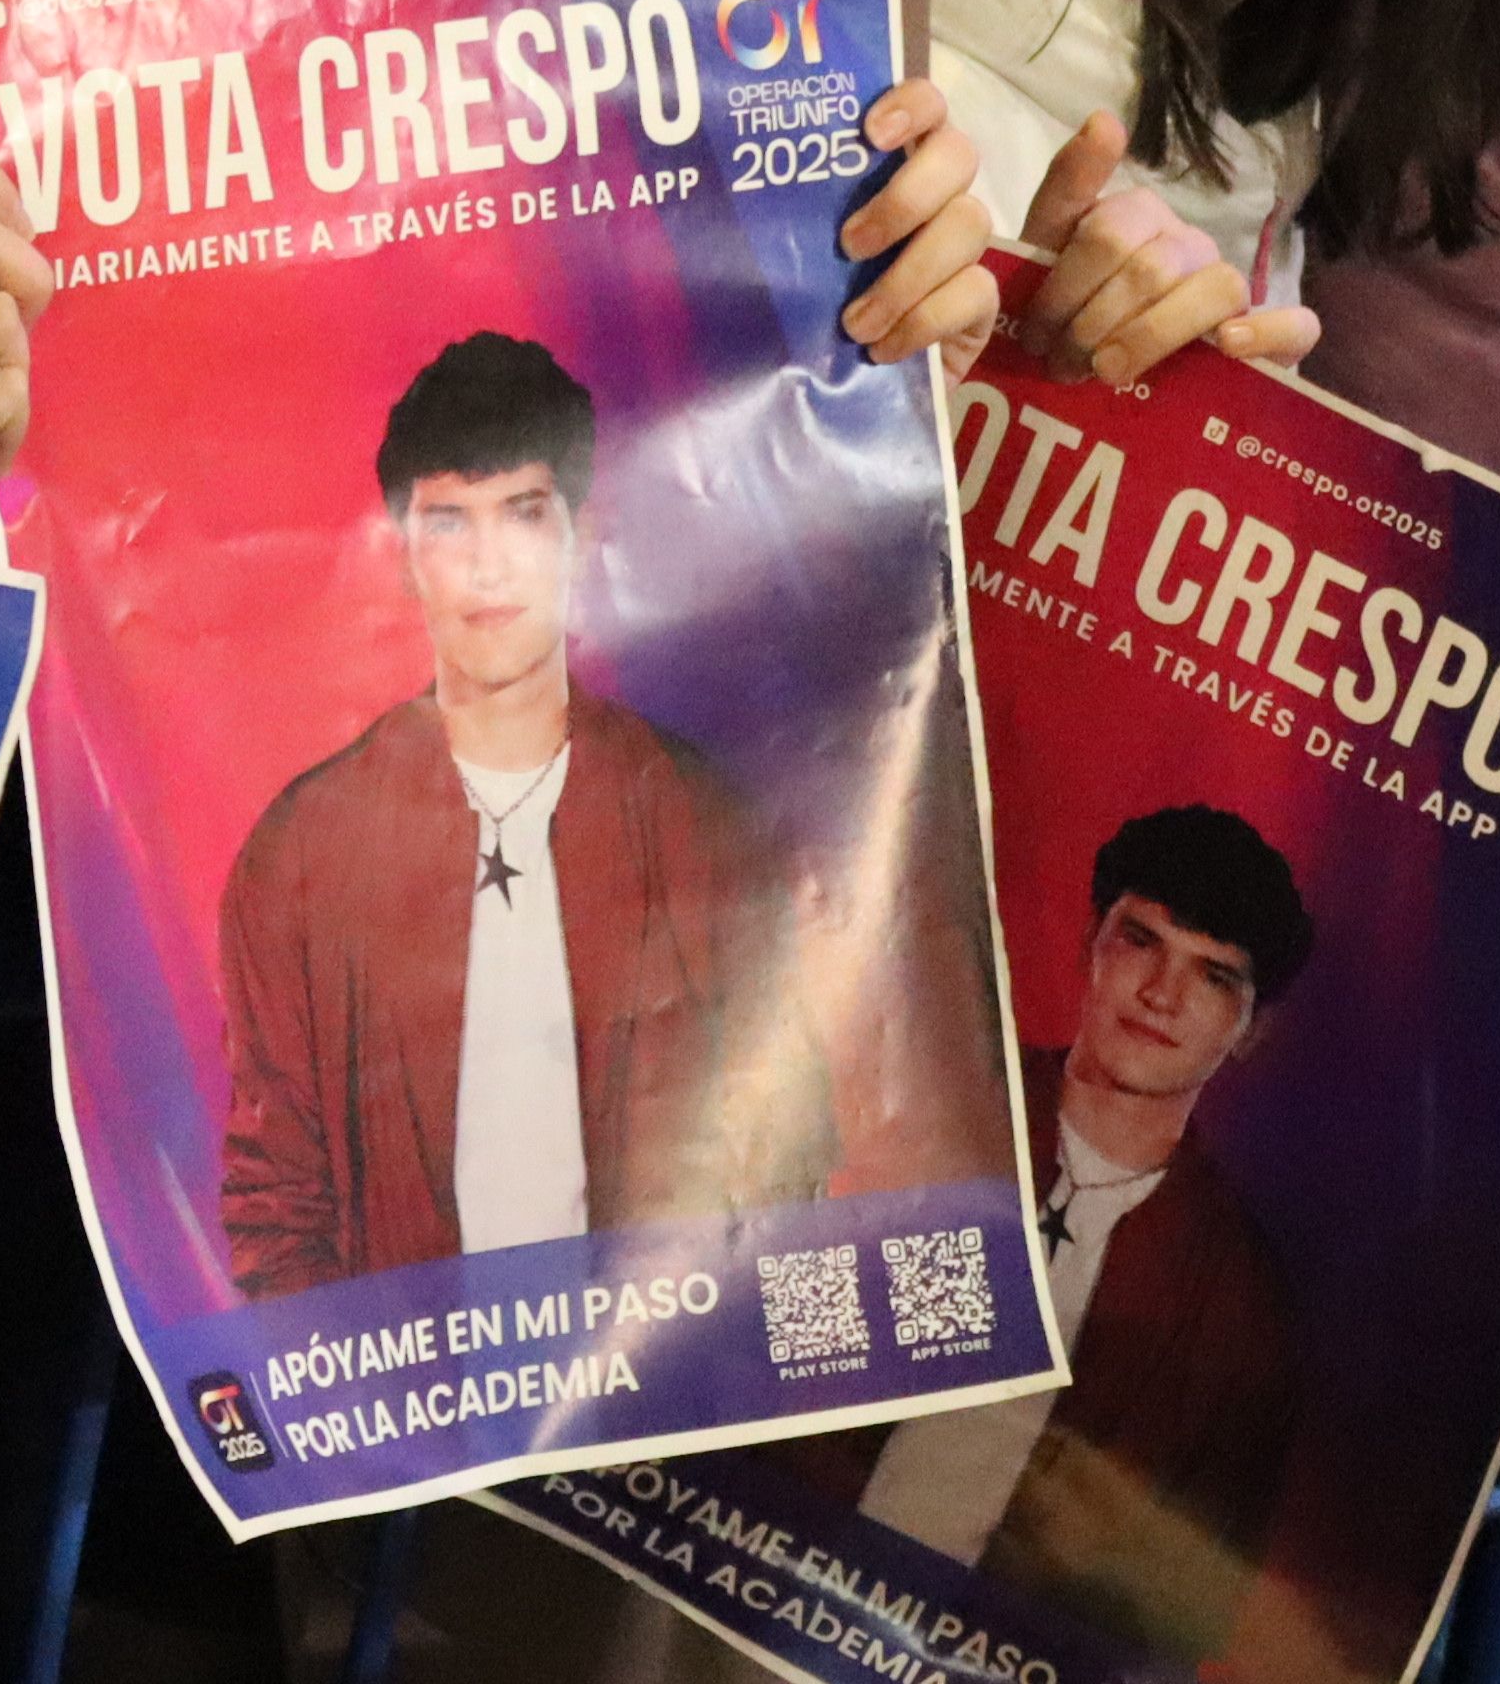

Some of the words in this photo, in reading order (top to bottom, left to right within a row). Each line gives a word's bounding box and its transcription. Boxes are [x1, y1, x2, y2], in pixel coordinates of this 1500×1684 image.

[727, 68, 856, 108] OPERACIÓN
[729, 94, 861, 137] TRIUNFO
[731, 128, 870, 193] 2025
[53, 224, 295, 291] IARIAMENTE
[309, 220, 335, 254] A
[347, 190, 498, 246] TRAVÉS
[511, 186, 559, 226] DE
[571, 175, 616, 216] LA
[628, 165, 701, 209] APP
[951, 380, 1126, 590] OTA
[1235, 434, 1445, 551] @crespo.ot2025
[1108, 630, 1134, 660] A
[1153, 644, 1296, 739] TRAVÉS
[1304, 725, 1355, 773] DE
[1361, 757, 1406, 802] LA
[1419, 790, 1498, 841] APP
[265, 1317, 438, 1401] APÓYAME
[446, 1309, 504, 1356] EN
[515, 1292, 572, 1342] MI
[583, 1271, 720, 1332] PASO
[778, 1362, 817, 1381] PLAY
[819, 1356, 869, 1376] STORE
[910, 1345, 940, 1362] APP
[942, 1336, 992, 1357] STORE
[219, 1432, 267, 1462] 2025
[284, 1412, 358, 1463] POR
[352, 1404, 400, 1450] LA
[404, 1350, 641, 1436] ACADEMIA
[543, 1474, 637, 1538] POR
[643, 1527, 694, 1574] LA
[797, 1546, 862, 1600] EN
[863, 1580, 927, 1633] MI
[927, 1612, 1058, 1684] PASO
